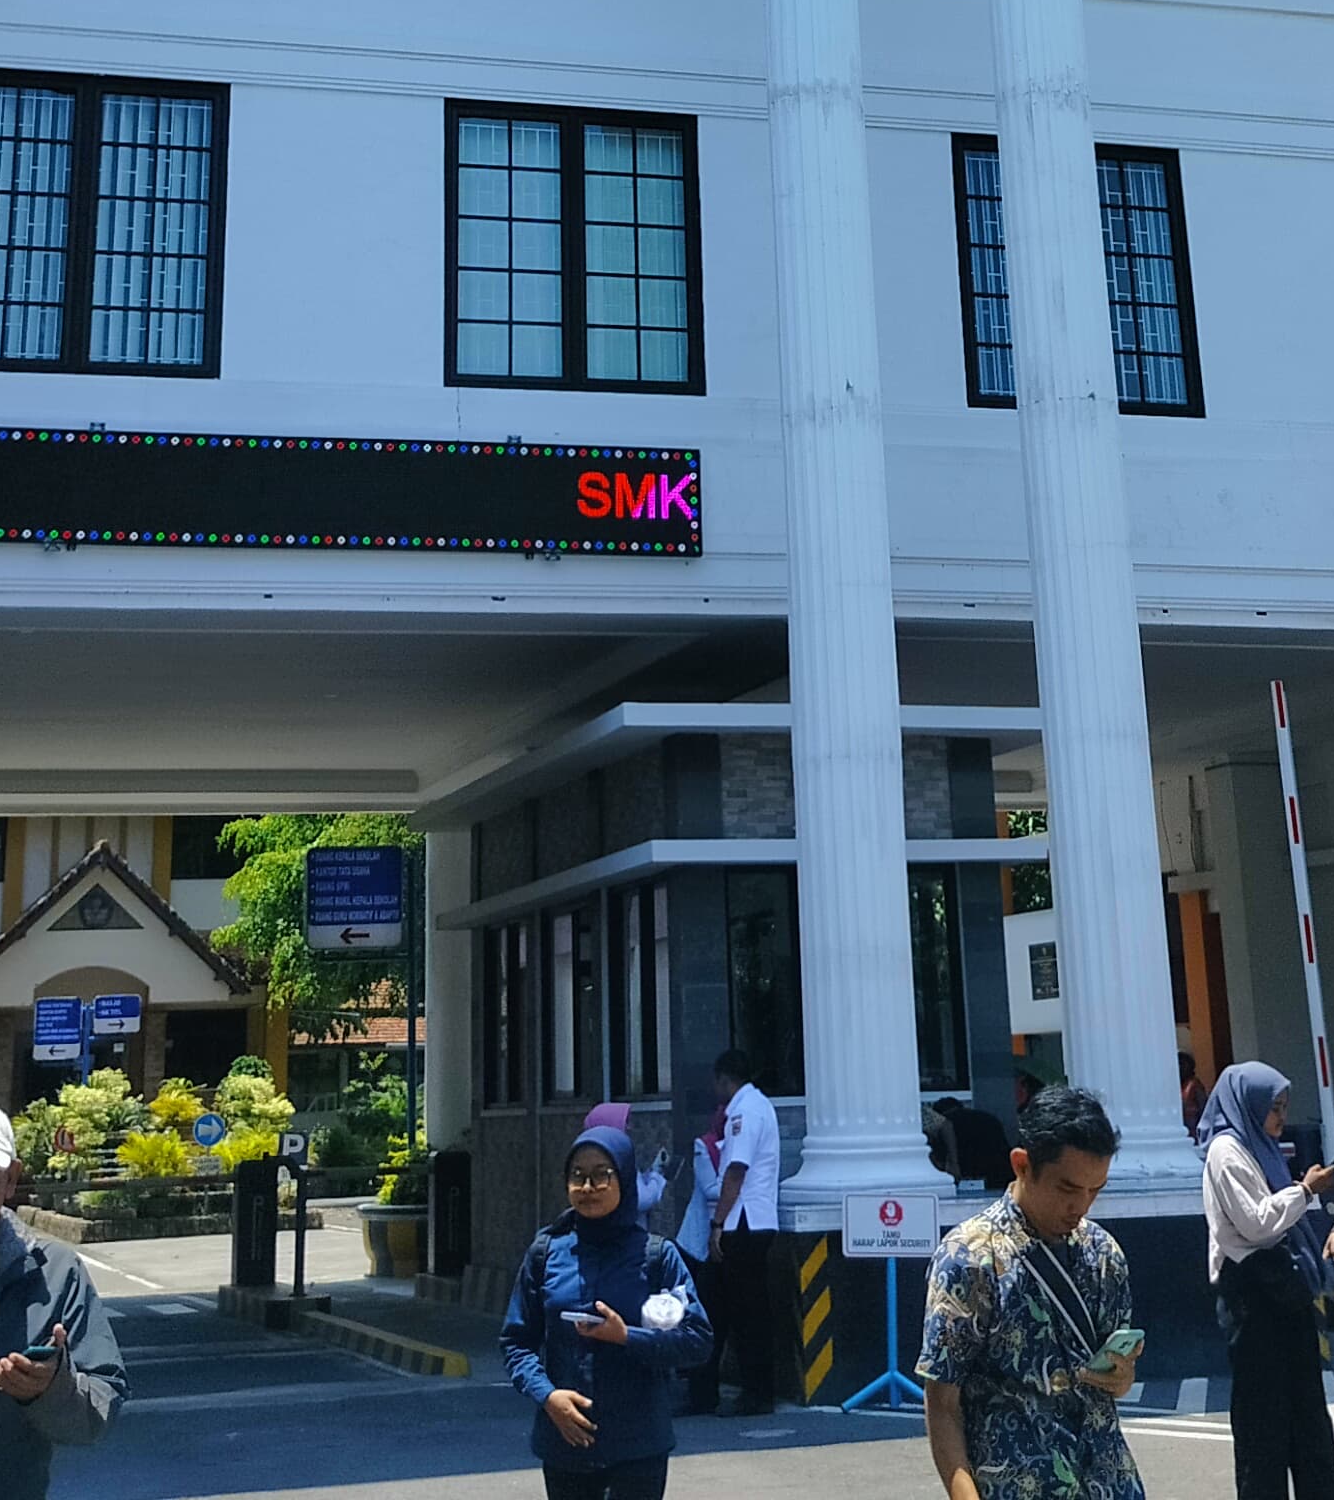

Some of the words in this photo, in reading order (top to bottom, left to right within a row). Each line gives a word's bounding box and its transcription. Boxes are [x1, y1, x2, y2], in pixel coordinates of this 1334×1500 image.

[576, 471, 692, 520] SMK
[282, 1133, 305, 1156] P
[882, 1230, 901, 1239] TAMU
[852, 1238, 876, 1247] HARAP
[877, 1238, 898, 1248] LAPOR
[899, 1238, 931, 1248] SECURITY
